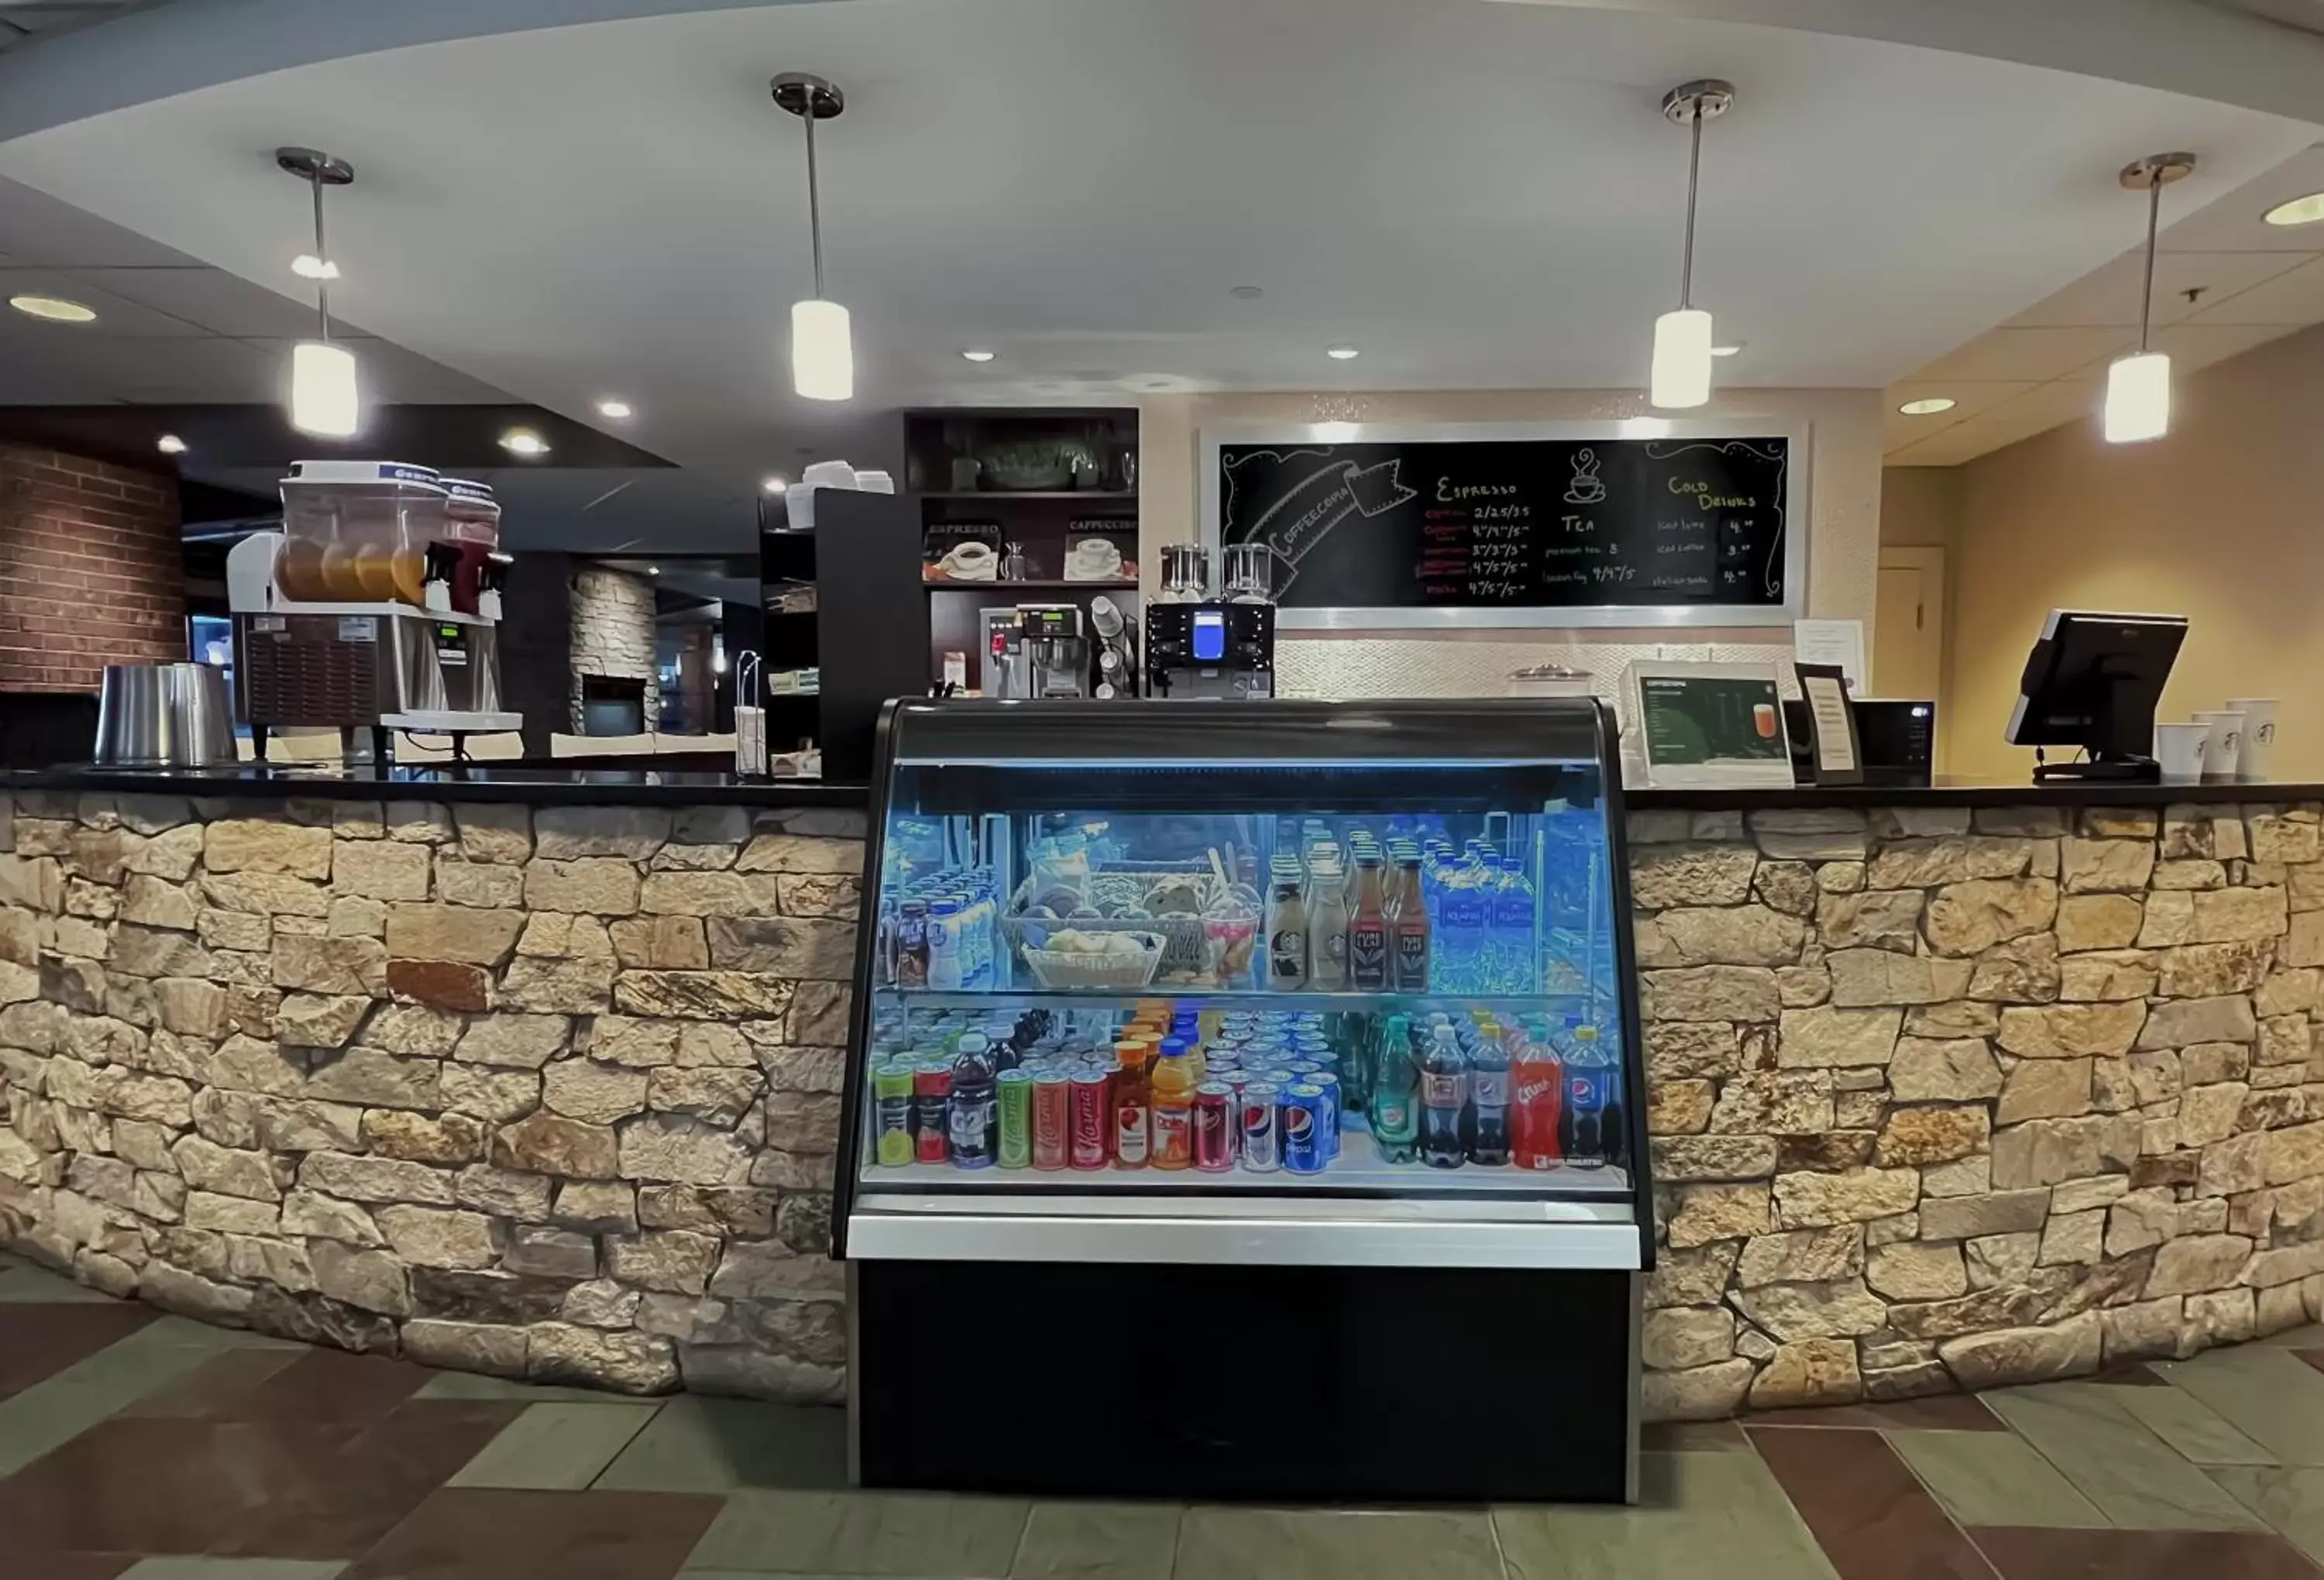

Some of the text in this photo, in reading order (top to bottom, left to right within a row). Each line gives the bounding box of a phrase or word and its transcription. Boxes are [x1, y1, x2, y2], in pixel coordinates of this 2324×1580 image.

[1667, 476, 1708, 494] COLD
[1697, 493, 1756, 510] DRINKS
[1561, 514, 1594, 533] TEA
